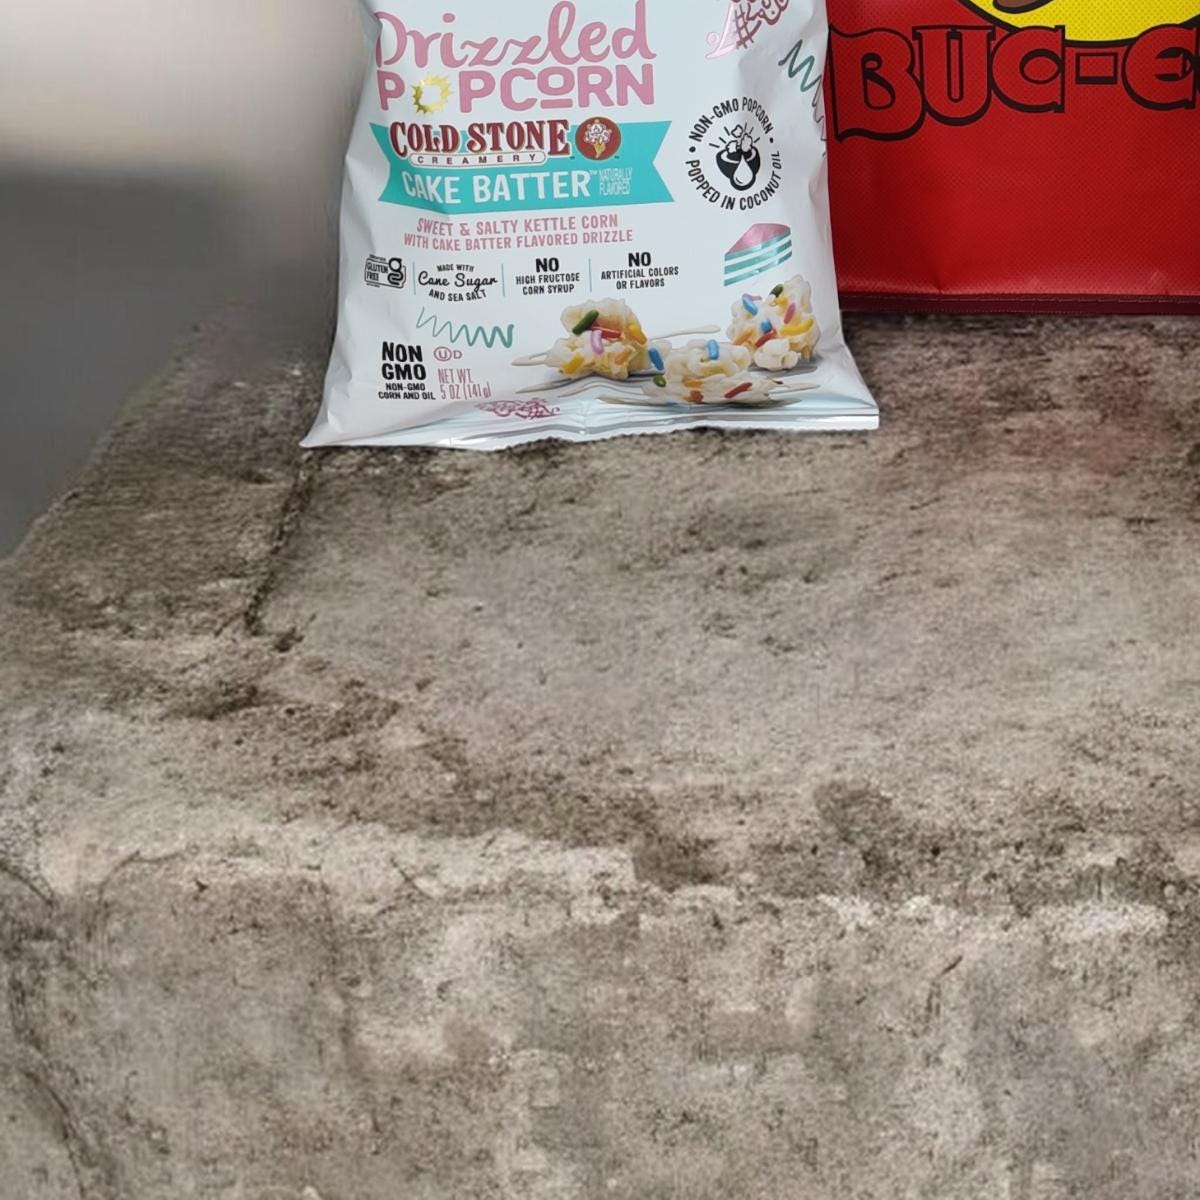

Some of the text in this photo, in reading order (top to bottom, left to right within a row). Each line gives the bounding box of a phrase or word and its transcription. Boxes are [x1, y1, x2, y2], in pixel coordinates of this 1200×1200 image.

[376, 64, 655, 115] POPCORN
[688, 96, 774, 142] NON-GMO POPCORN
[389, 119, 571, 157] COLD STONE
[417, 153, 537, 165] CREAMERY
[401, 170, 461, 204] CAKE
[685, 150, 782, 211] POPPED IN COCONUT OIL
[416, 214, 619, 236] SWEET & SALTY KETTLE CORN
[404, 229, 633, 251] WITH CAKE BATTER FLAVORED DRIZZLE
[535, 257, 560, 273] NO
[628, 252, 652, 267] NO
[437, 263, 475, 273] MADE WITH
[600, 266, 679, 280] ARTIFICIAL COLORS
[418, 270, 498, 292] Cane Sugar
[515, 272, 581, 285] HIGH FRUCTOSE
[616, 278, 665, 290] OR FLAVORS
[428, 289, 487, 302] AND SEA SALT
[522, 283, 575, 295] CORN SYRUP
[381, 341, 424, 362] NON
[381, 363, 427, 381] GMO
[437, 368, 455, 384] NET
[385, 382, 426, 391] NON-GMO
[440, 384, 446, 399] 5
[449, 384, 461, 399] OZ
[378, 391, 436, 400] CORN AND OIL
